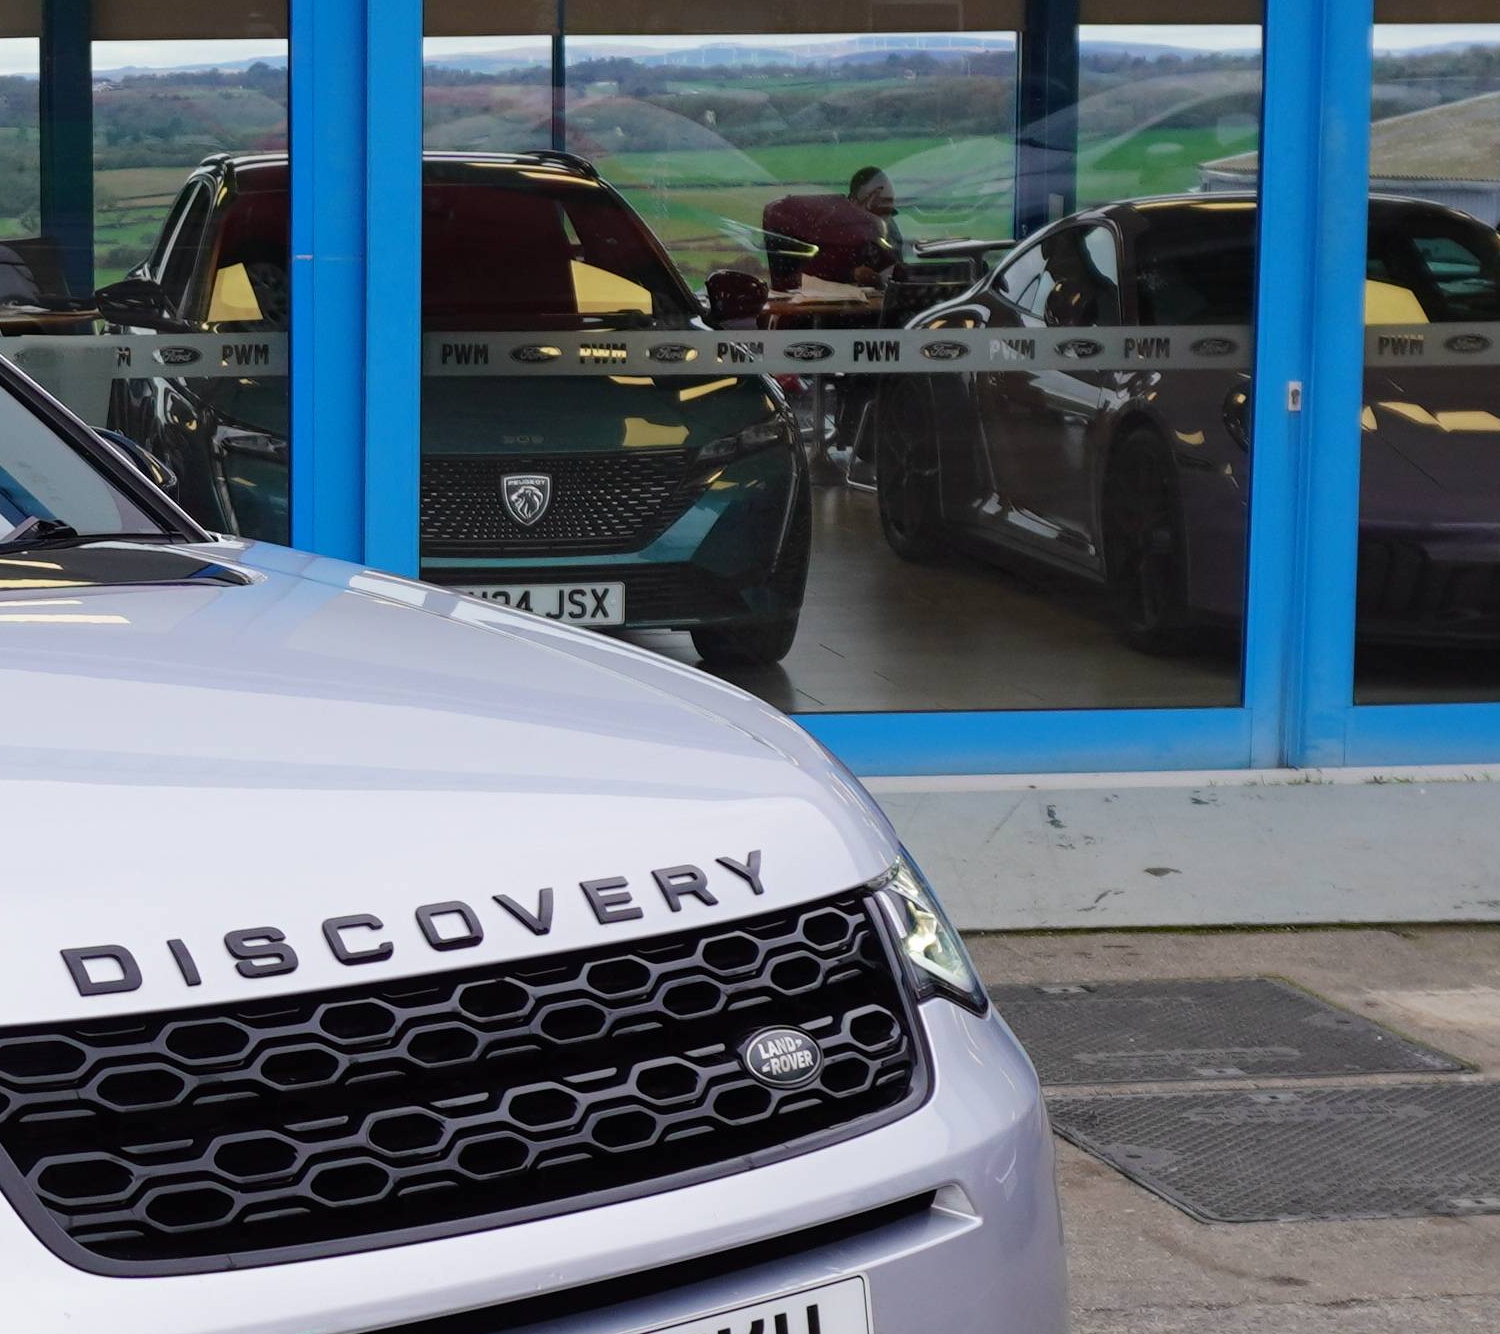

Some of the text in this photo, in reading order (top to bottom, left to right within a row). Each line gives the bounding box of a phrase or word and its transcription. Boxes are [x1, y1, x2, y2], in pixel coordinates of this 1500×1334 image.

[222, 344, 269, 365] PWM
[441, 344, 489, 365] PWM
[717, 342, 764, 363] PWM
[853, 341, 900, 362] PWM
[1123, 338, 1170, 359] PWM
[545, 588, 610, 619] JSX
[58, 849, 768, 998] DISCOVERY
[757, 1036, 797, 1060] LAND
[769, 1049, 814, 1076] ROVER
